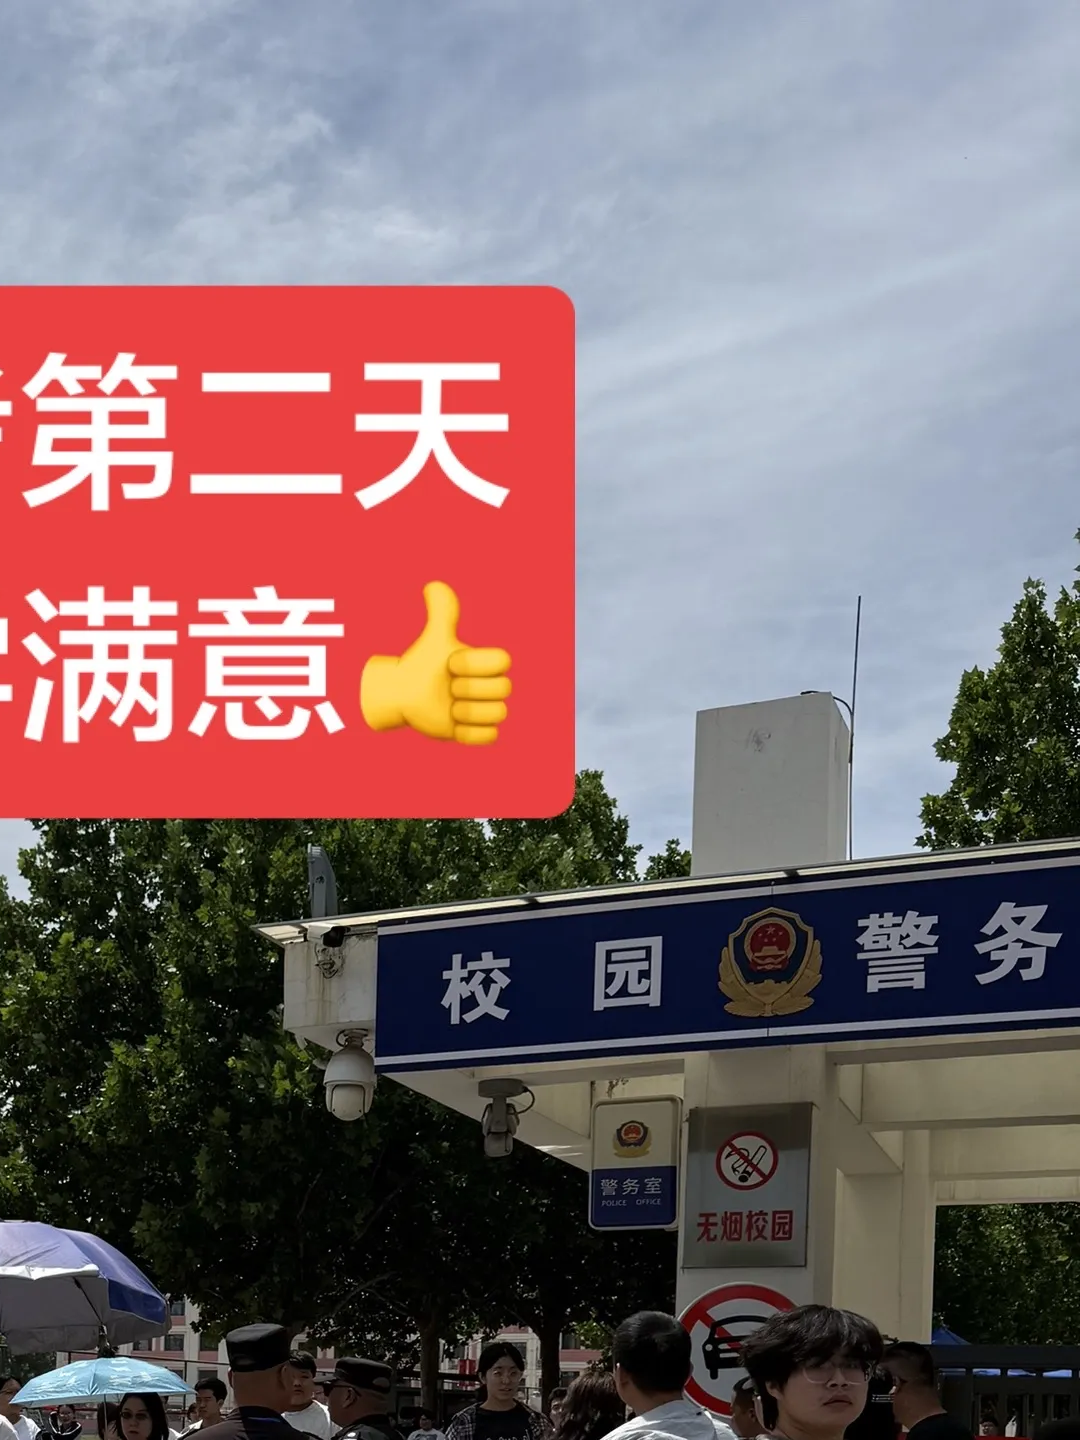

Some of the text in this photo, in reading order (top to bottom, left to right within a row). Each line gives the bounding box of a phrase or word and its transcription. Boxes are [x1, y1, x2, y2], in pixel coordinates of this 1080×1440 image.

[600, 1177, 662, 1196] 警务室
[635, 1198, 661, 1206] OFFICE
[696, 1210, 794, 1242] 无烟校园
